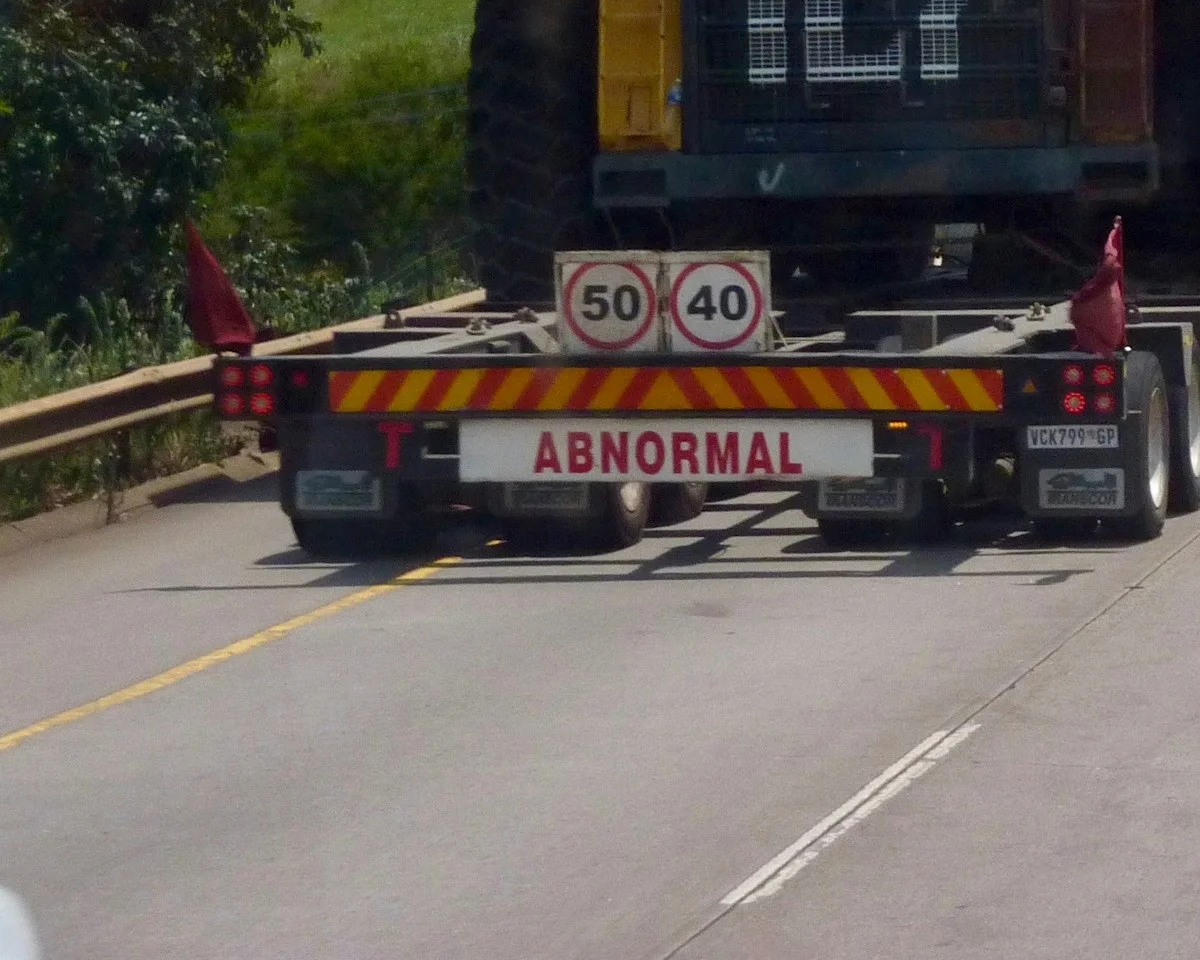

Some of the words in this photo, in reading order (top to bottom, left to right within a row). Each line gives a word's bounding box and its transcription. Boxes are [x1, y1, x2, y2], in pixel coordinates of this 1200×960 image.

[581, 284, 641, 322] 50
[687, 284, 748, 321] 40
[533, 430, 803, 475] ABNORMAL
[1029, 428, 1086, 446] VCK799
[1096, 427, 1115, 445] GP
